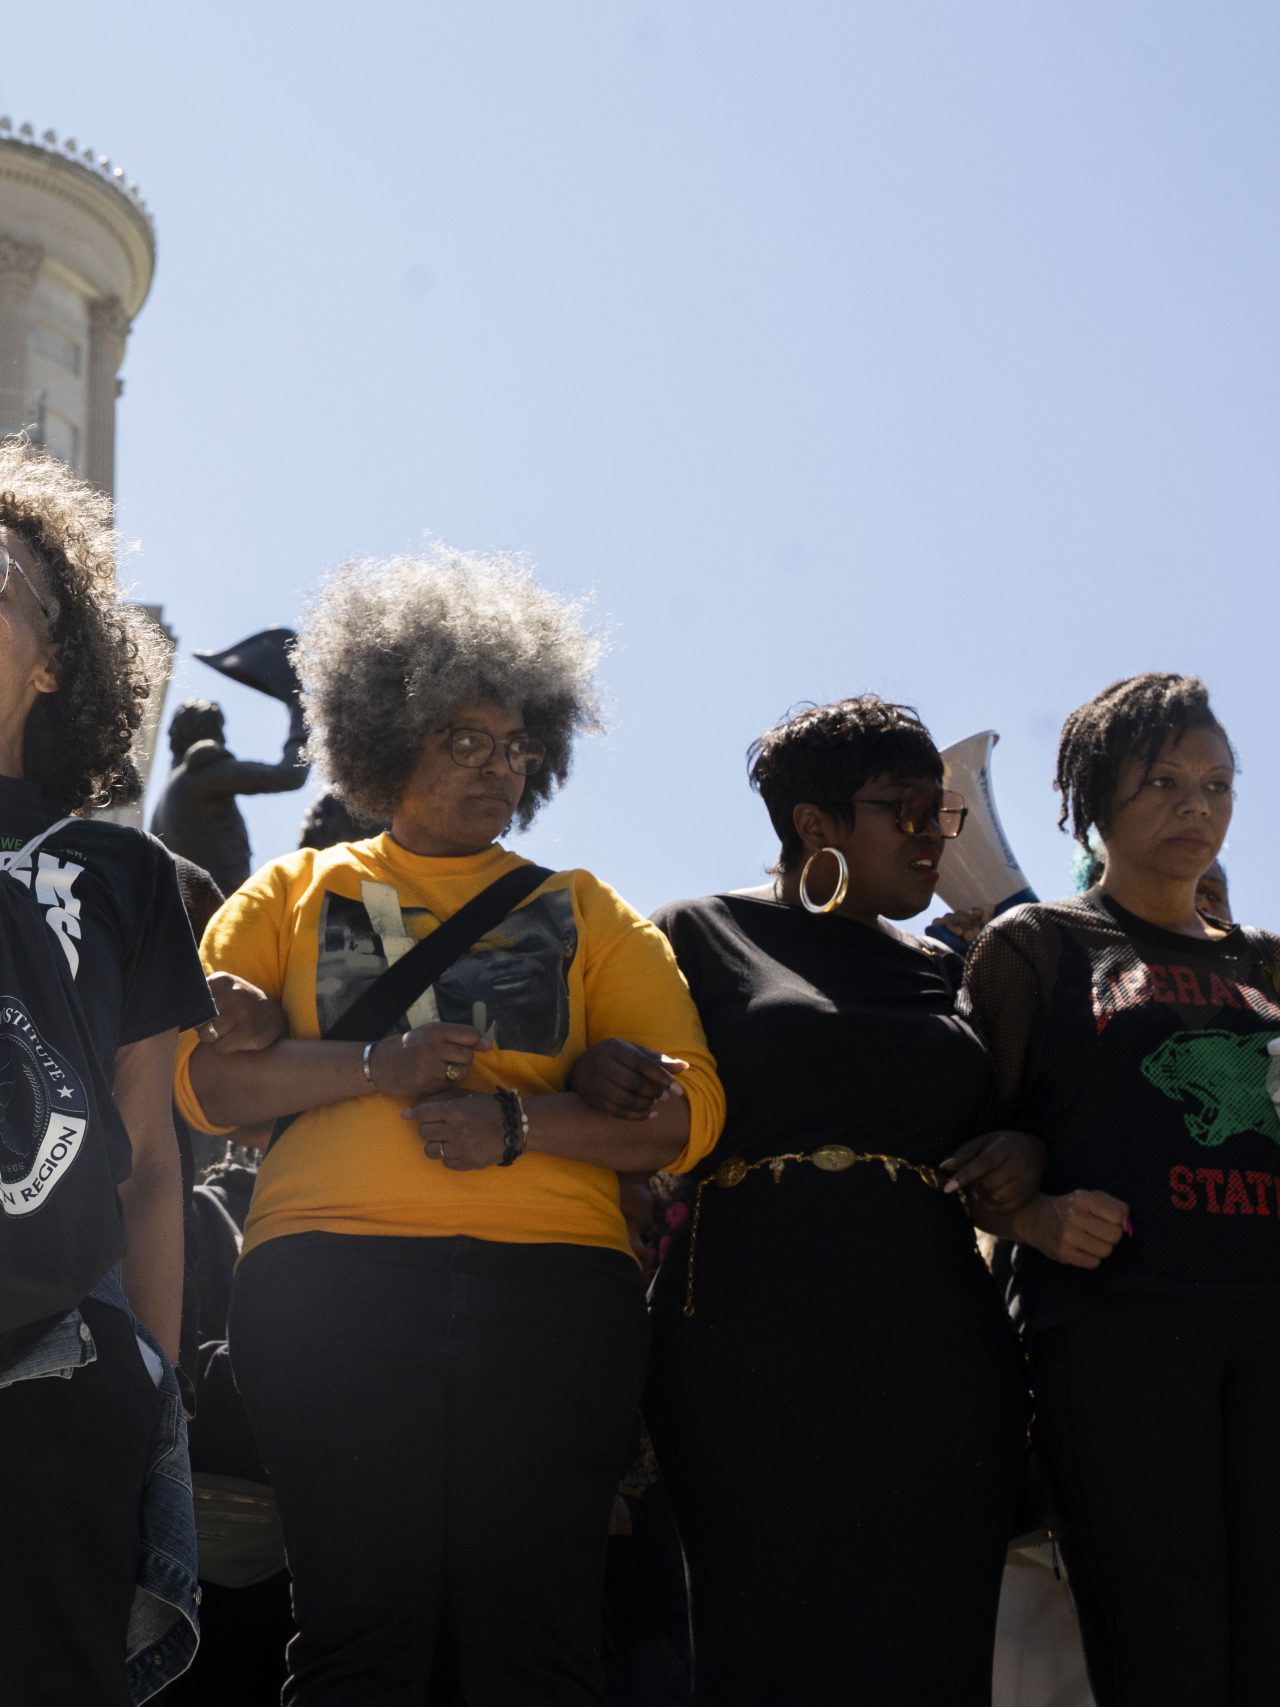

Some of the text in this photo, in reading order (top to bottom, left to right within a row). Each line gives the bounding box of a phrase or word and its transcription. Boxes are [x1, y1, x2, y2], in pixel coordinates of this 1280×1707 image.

[1, 836, 23, 850] WE
[2, 1007, 66, 1082] STITUTE
[20, 1126, 78, 1203] REGION
[1169, 1164, 1280, 1218] STAT
